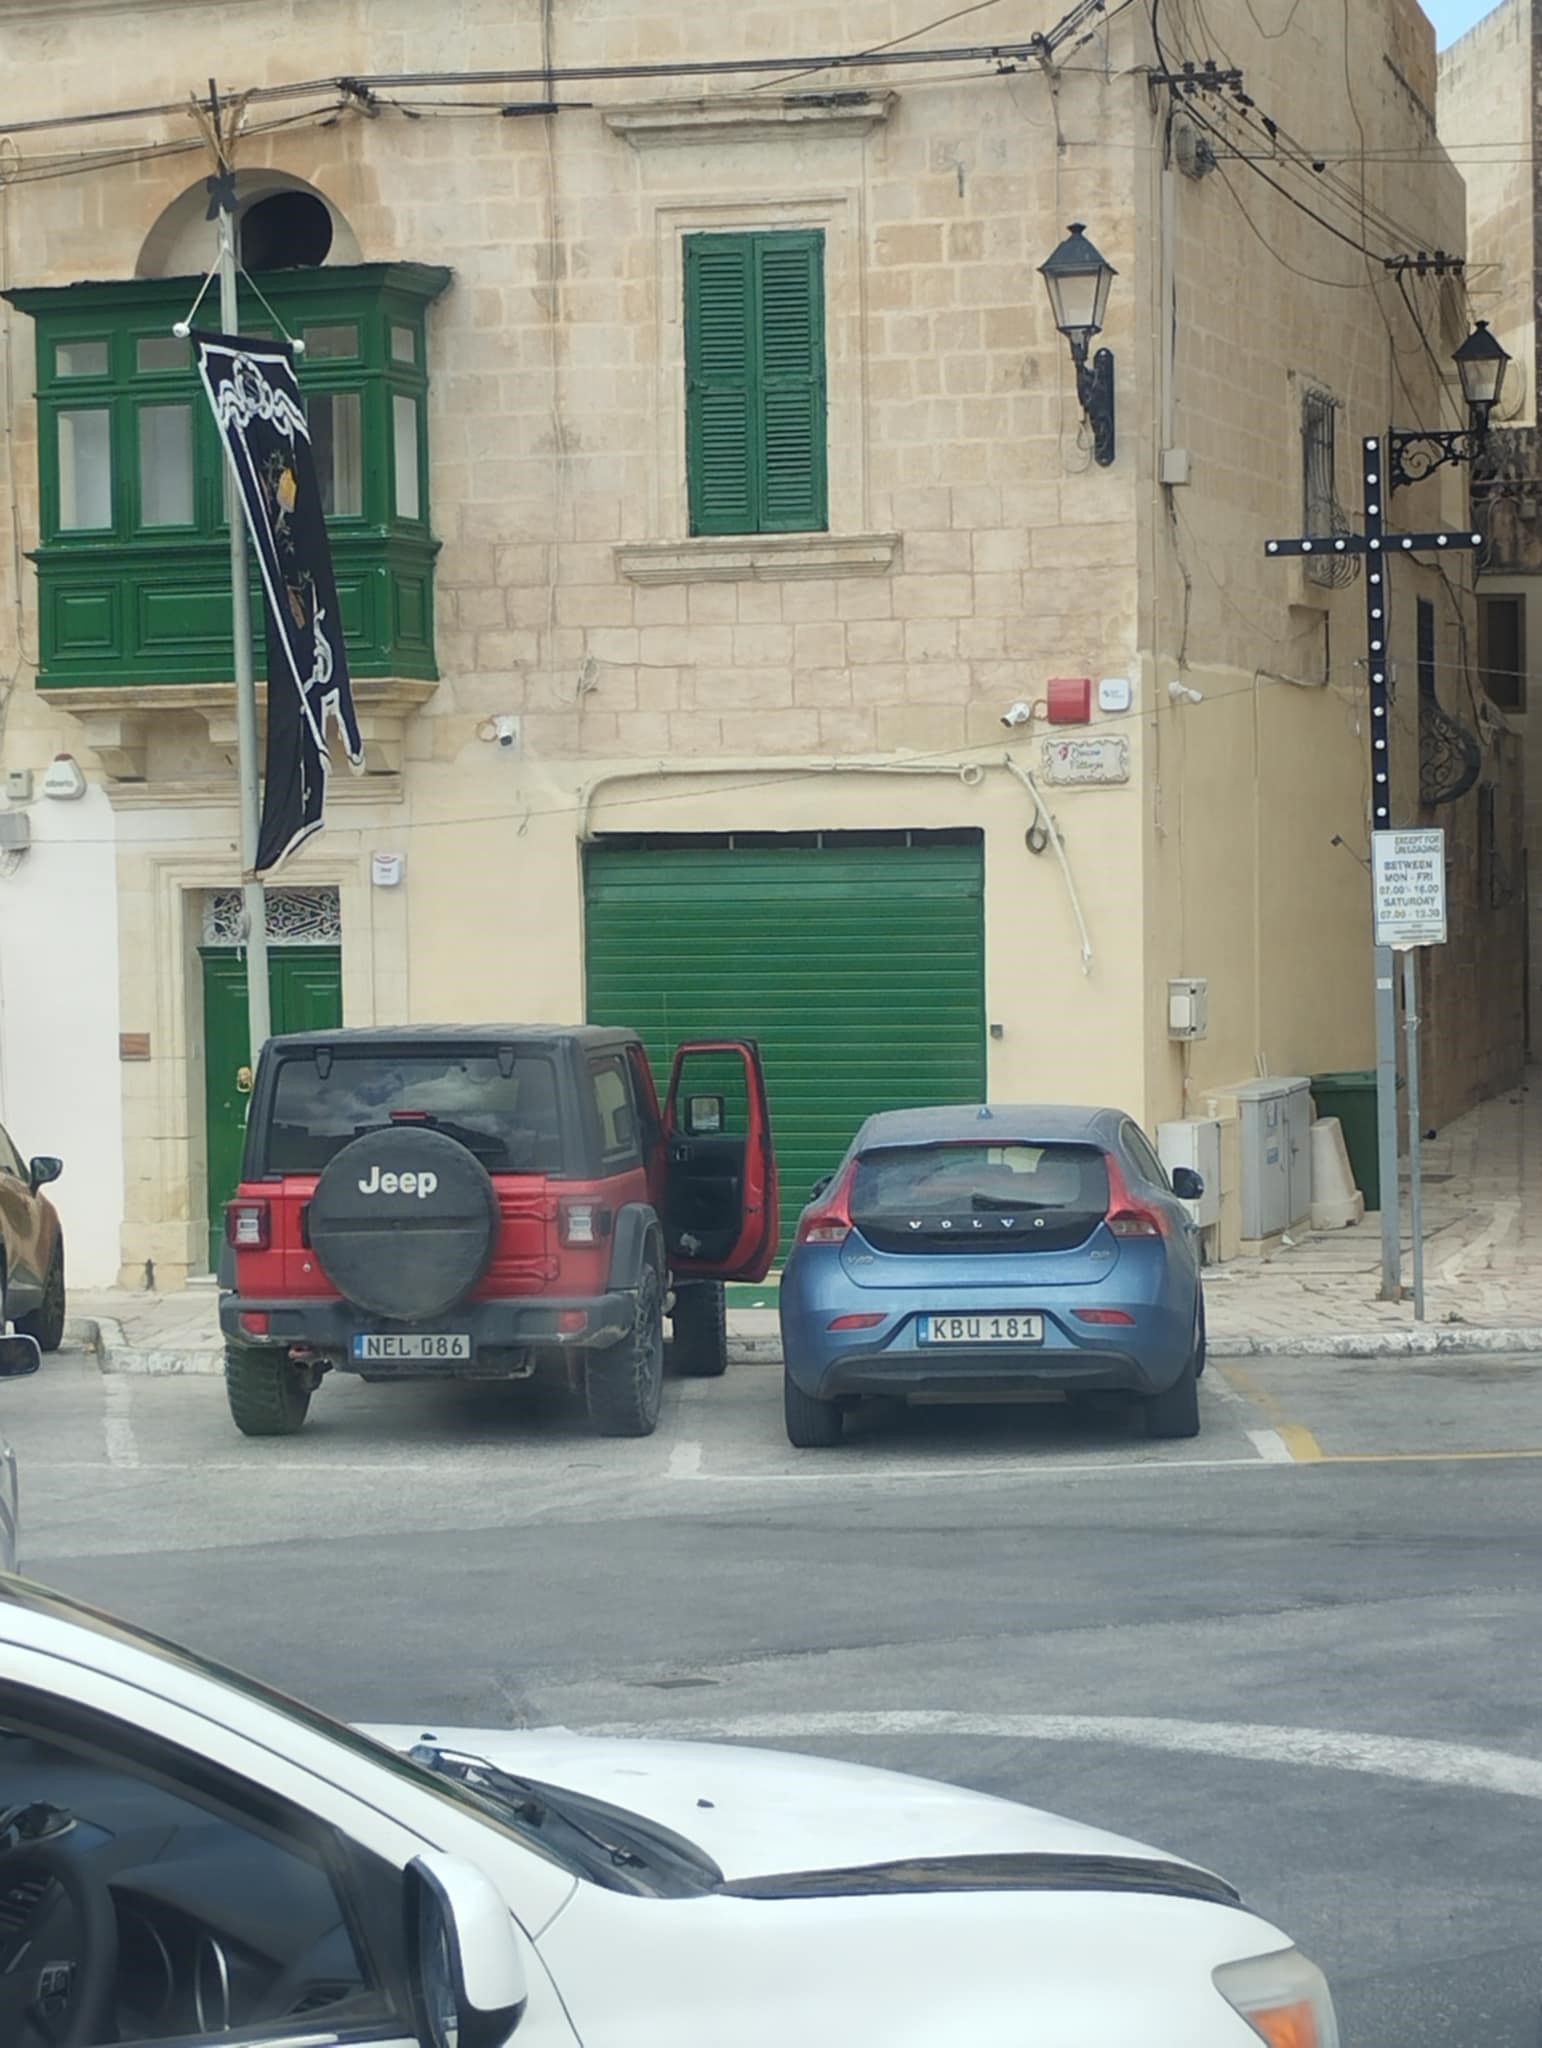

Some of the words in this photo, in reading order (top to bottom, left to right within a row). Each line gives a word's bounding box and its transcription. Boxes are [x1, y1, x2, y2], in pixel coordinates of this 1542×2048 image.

[1394, 836, 1423, 845] EXCEPT
[1383, 860, 1433, 870] BETWEEN
[1384, 872, 1408, 882] MON
[1416, 871, 1434, 881] FRI
[1384, 896, 1436, 907] SATURDAY
[358, 1166, 438, 1199] Jeep
[909, 1218, 1045, 1229] VOLVO
[933, 1318, 981, 1339] KBU
[990, 1317, 1036, 1339] 181
[366, 1337, 412, 1356] NEL
[420, 1337, 463, 1356] 086
